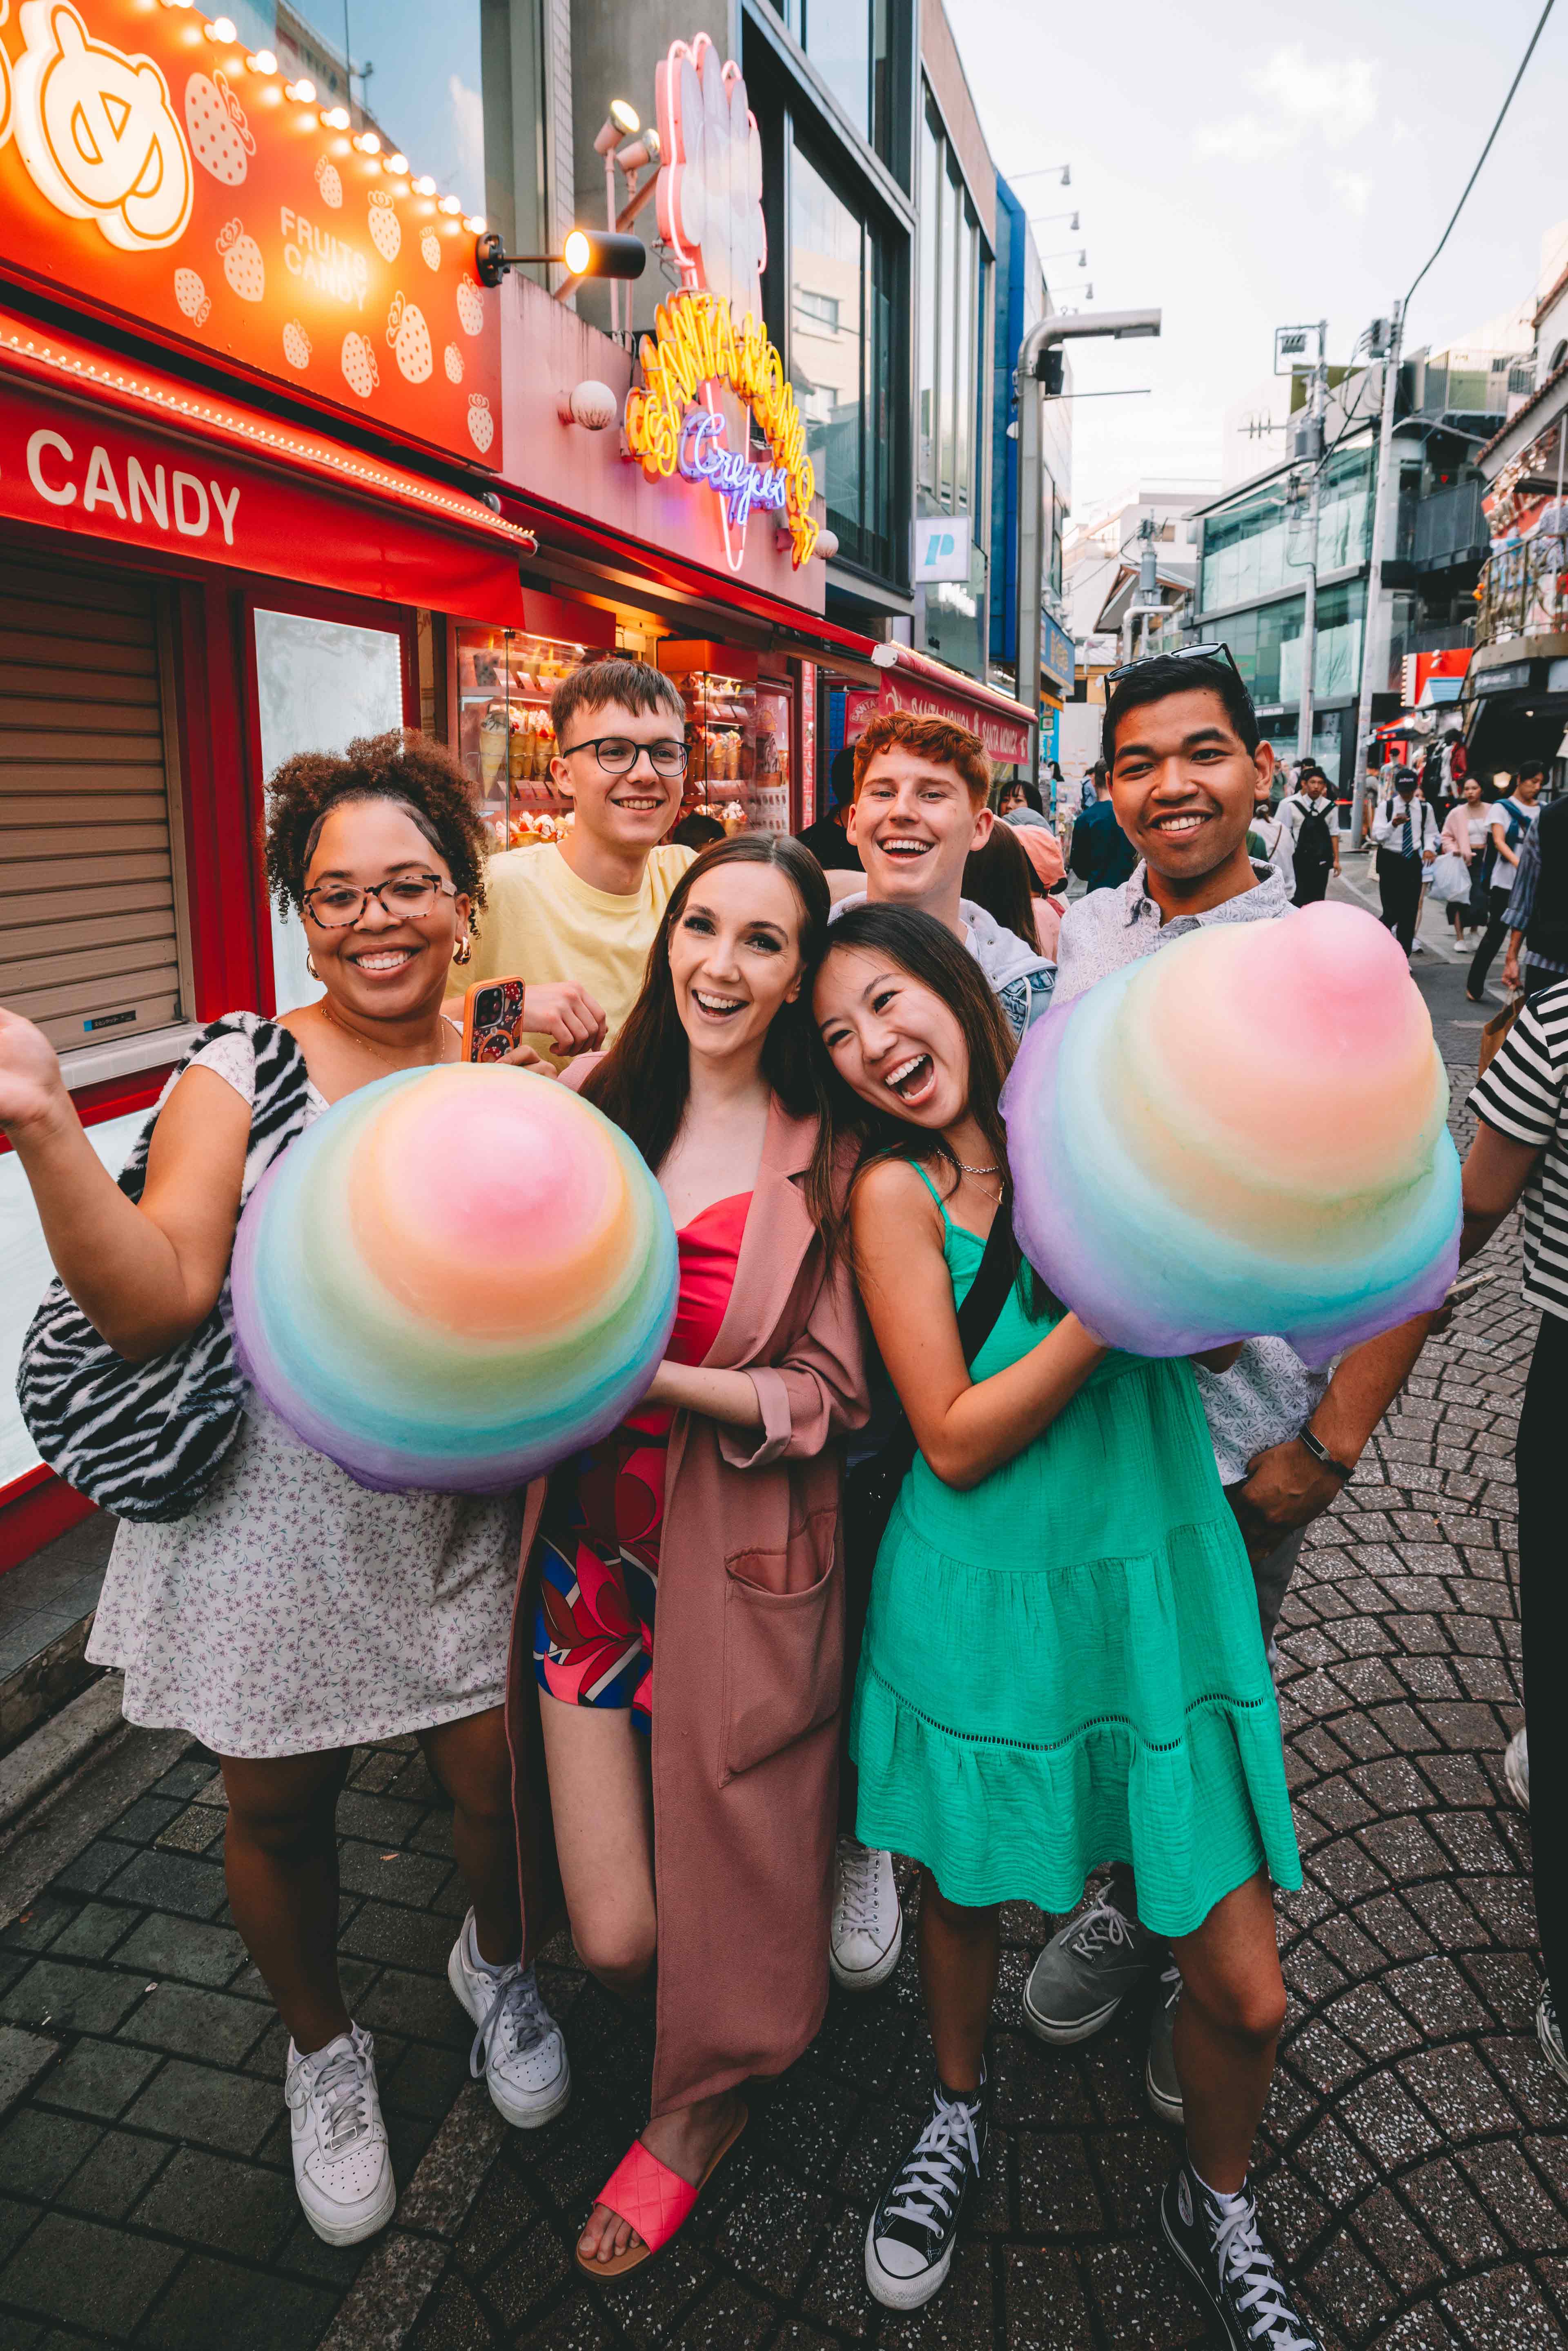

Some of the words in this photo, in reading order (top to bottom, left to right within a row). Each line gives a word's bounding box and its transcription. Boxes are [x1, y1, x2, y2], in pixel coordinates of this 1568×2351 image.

[0, 0, 194, 250] め
[281, 205, 367, 282] FRUITS
[284, 243, 367, 311] CANDY
[26, 429, 240, 546] CANDY
[924, 533, 955, 566] P
[982, 720, 1000, 752] SANTA
[1000, 726, 1017, 755] MONICA
